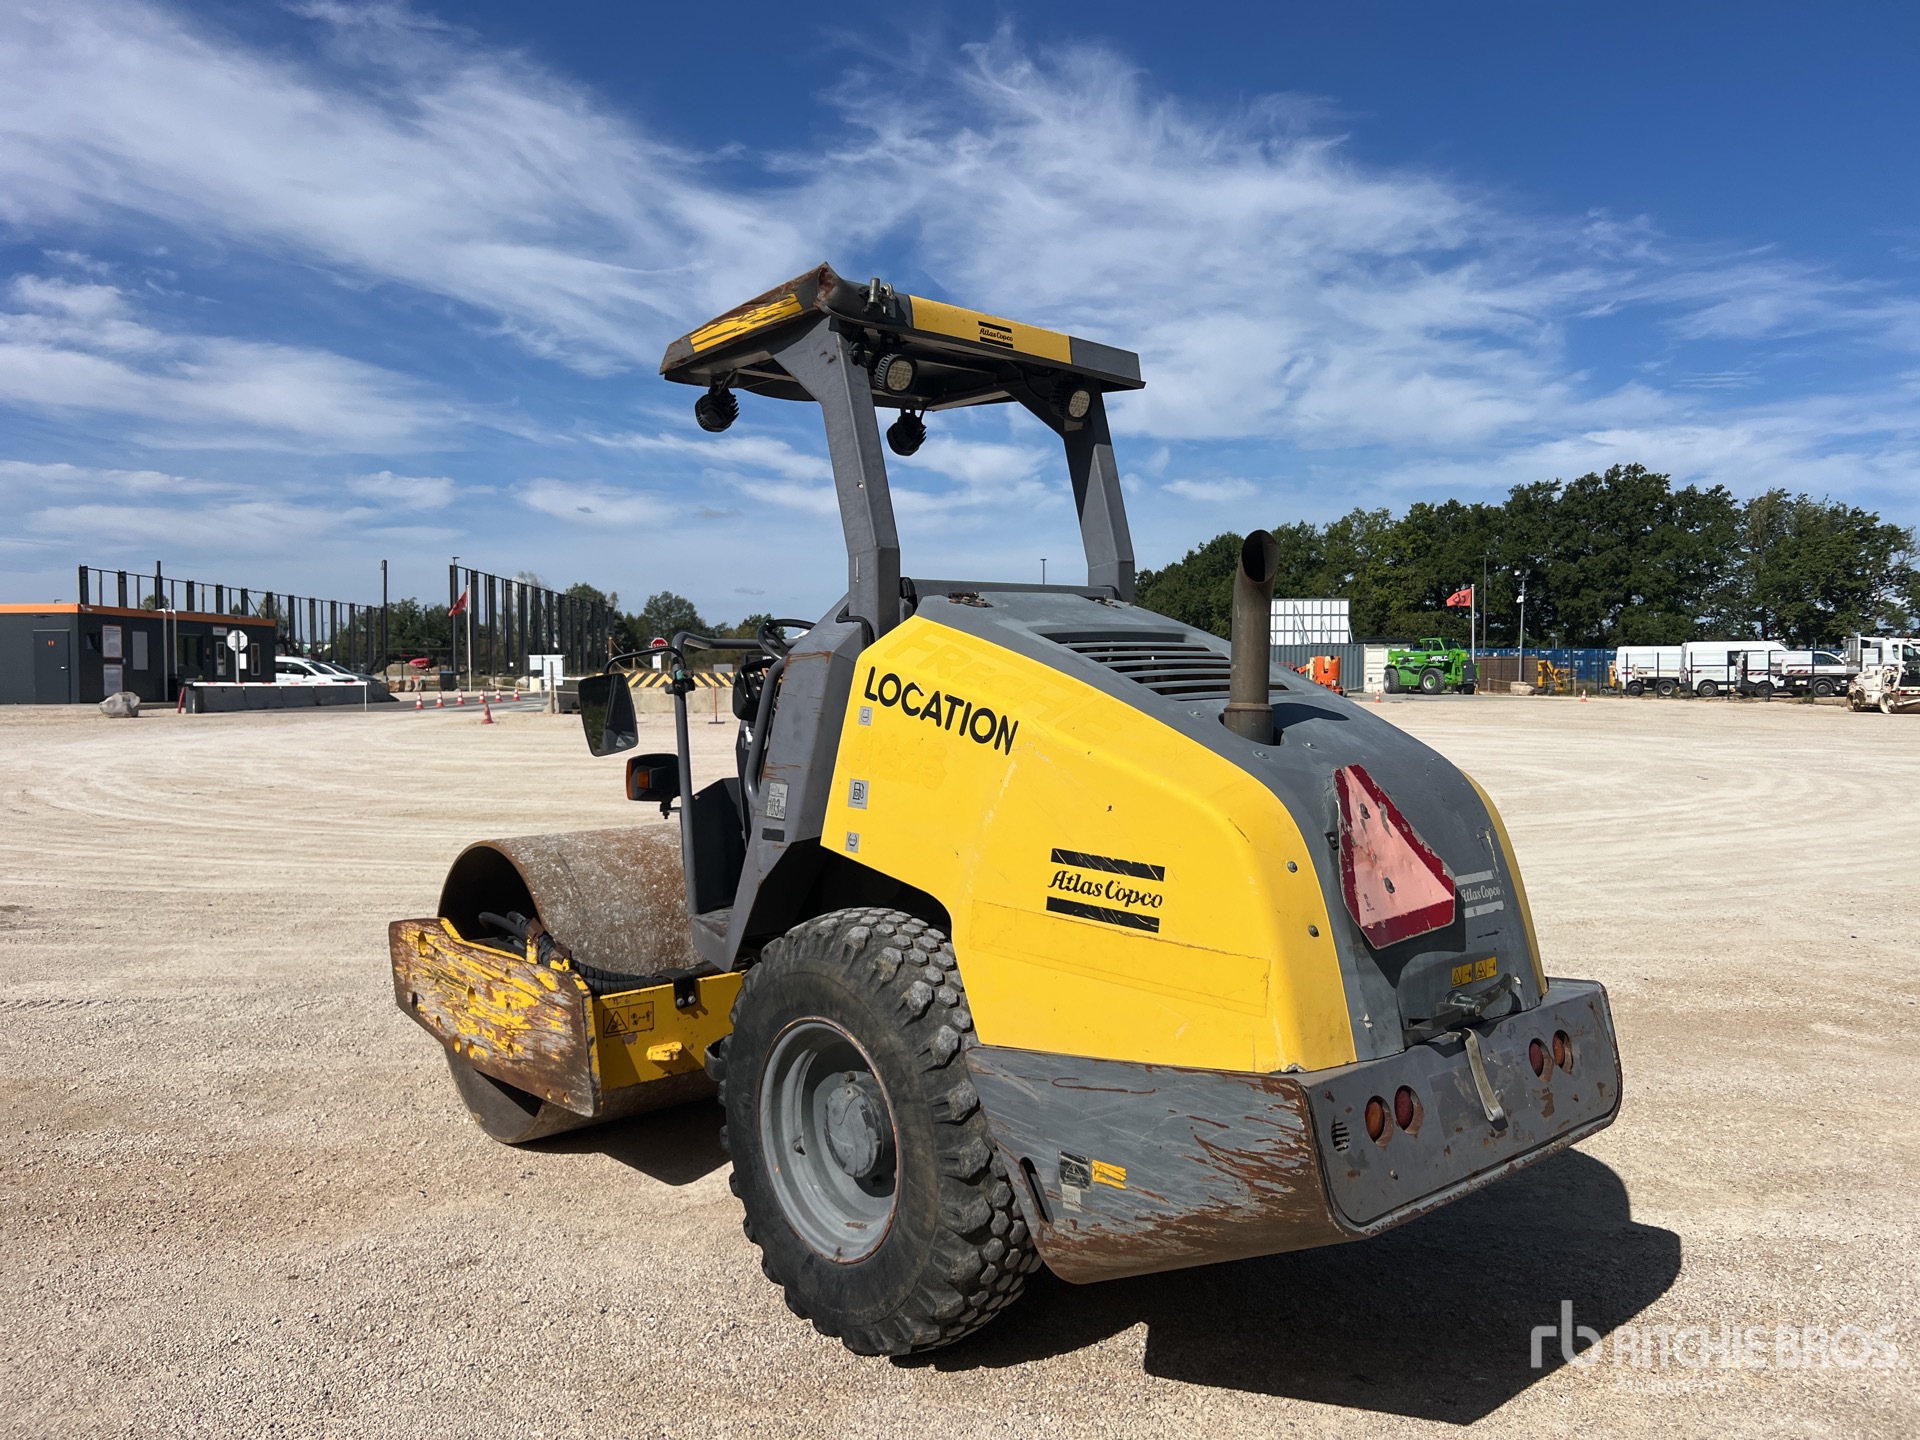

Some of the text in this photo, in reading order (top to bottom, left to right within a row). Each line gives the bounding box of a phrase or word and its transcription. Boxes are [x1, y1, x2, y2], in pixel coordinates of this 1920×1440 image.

[979, 328, 1014, 341] Atlas Copco
[864, 666, 1019, 756] LOCATION
[1048, 870, 1163, 908] Atlas Copco
[1461, 885, 1501, 902] Atlas Copco
